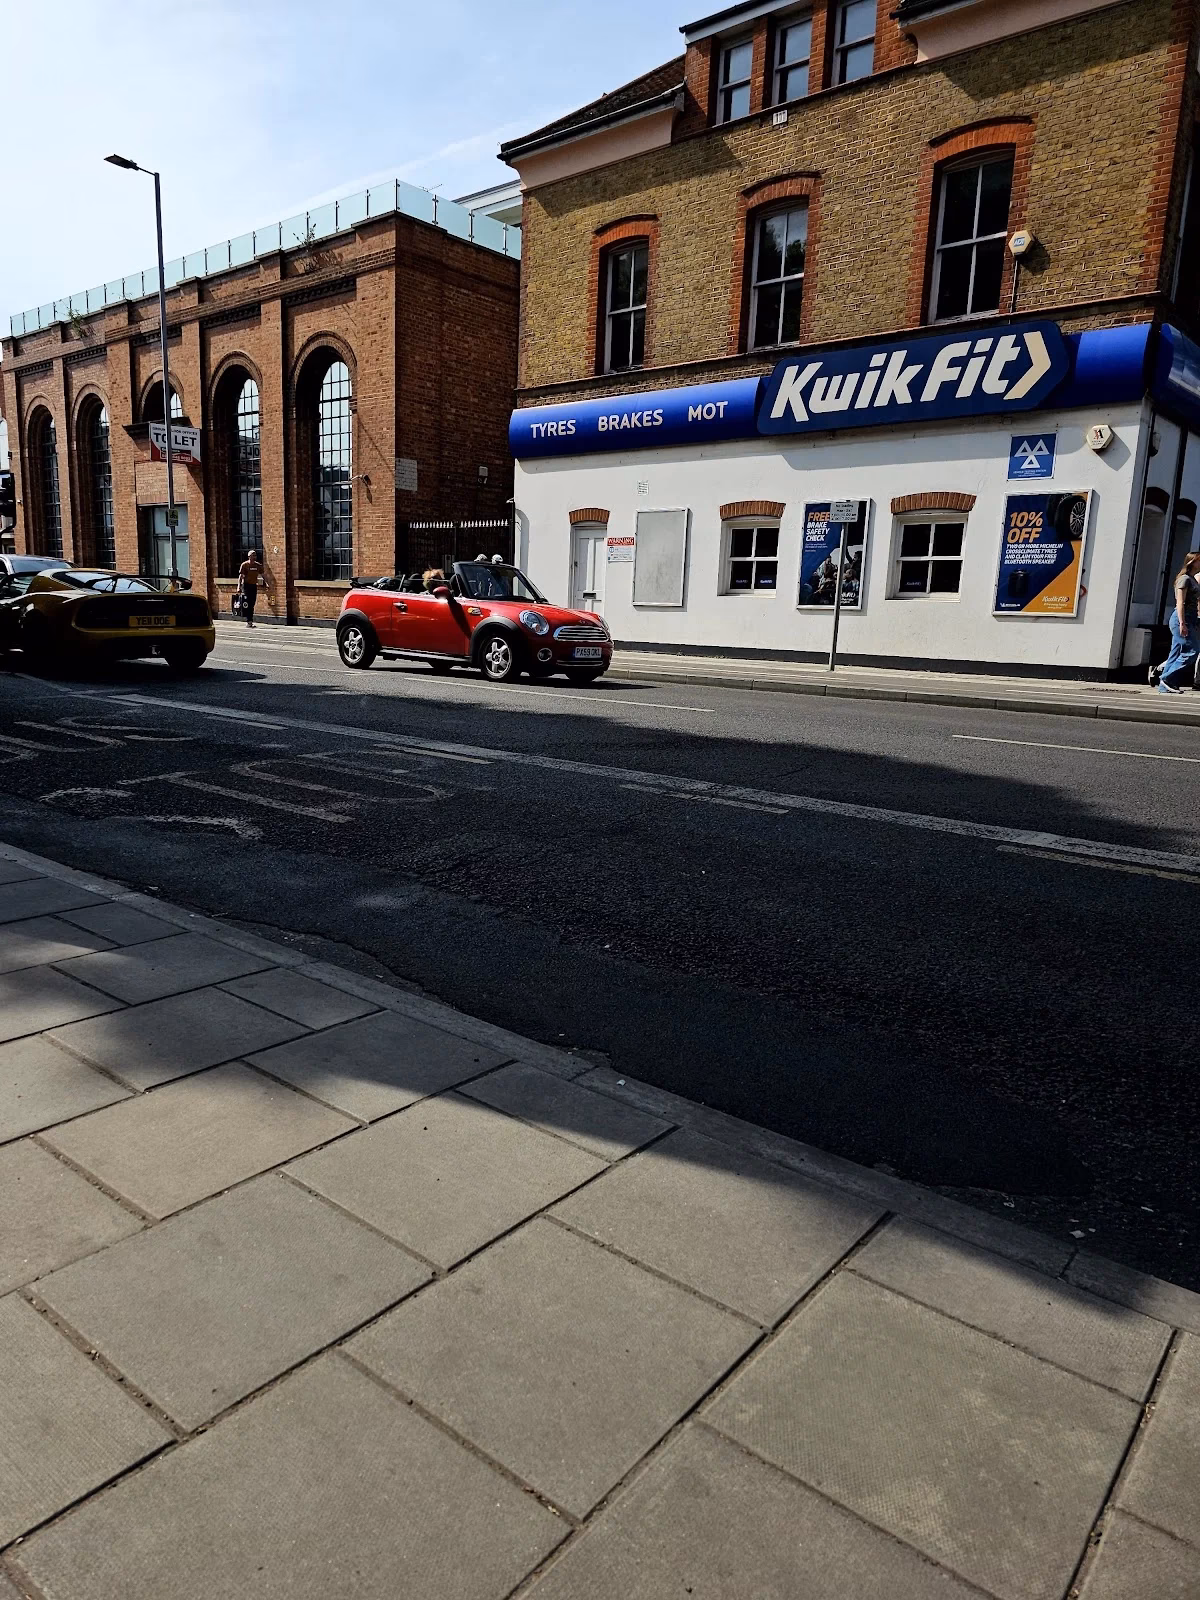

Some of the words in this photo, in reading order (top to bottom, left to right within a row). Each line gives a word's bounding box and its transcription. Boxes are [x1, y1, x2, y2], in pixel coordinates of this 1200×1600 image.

[530, 419, 576, 439] TYRES
[598, 409, 663, 432] BRAKES
[687, 401, 729, 422] MOT
[174, 435, 197, 447] LET
[808, 511, 830, 522] FREE
[1010, 511, 1043, 527] 10%
[1007, 527, 1042, 543] OFF
